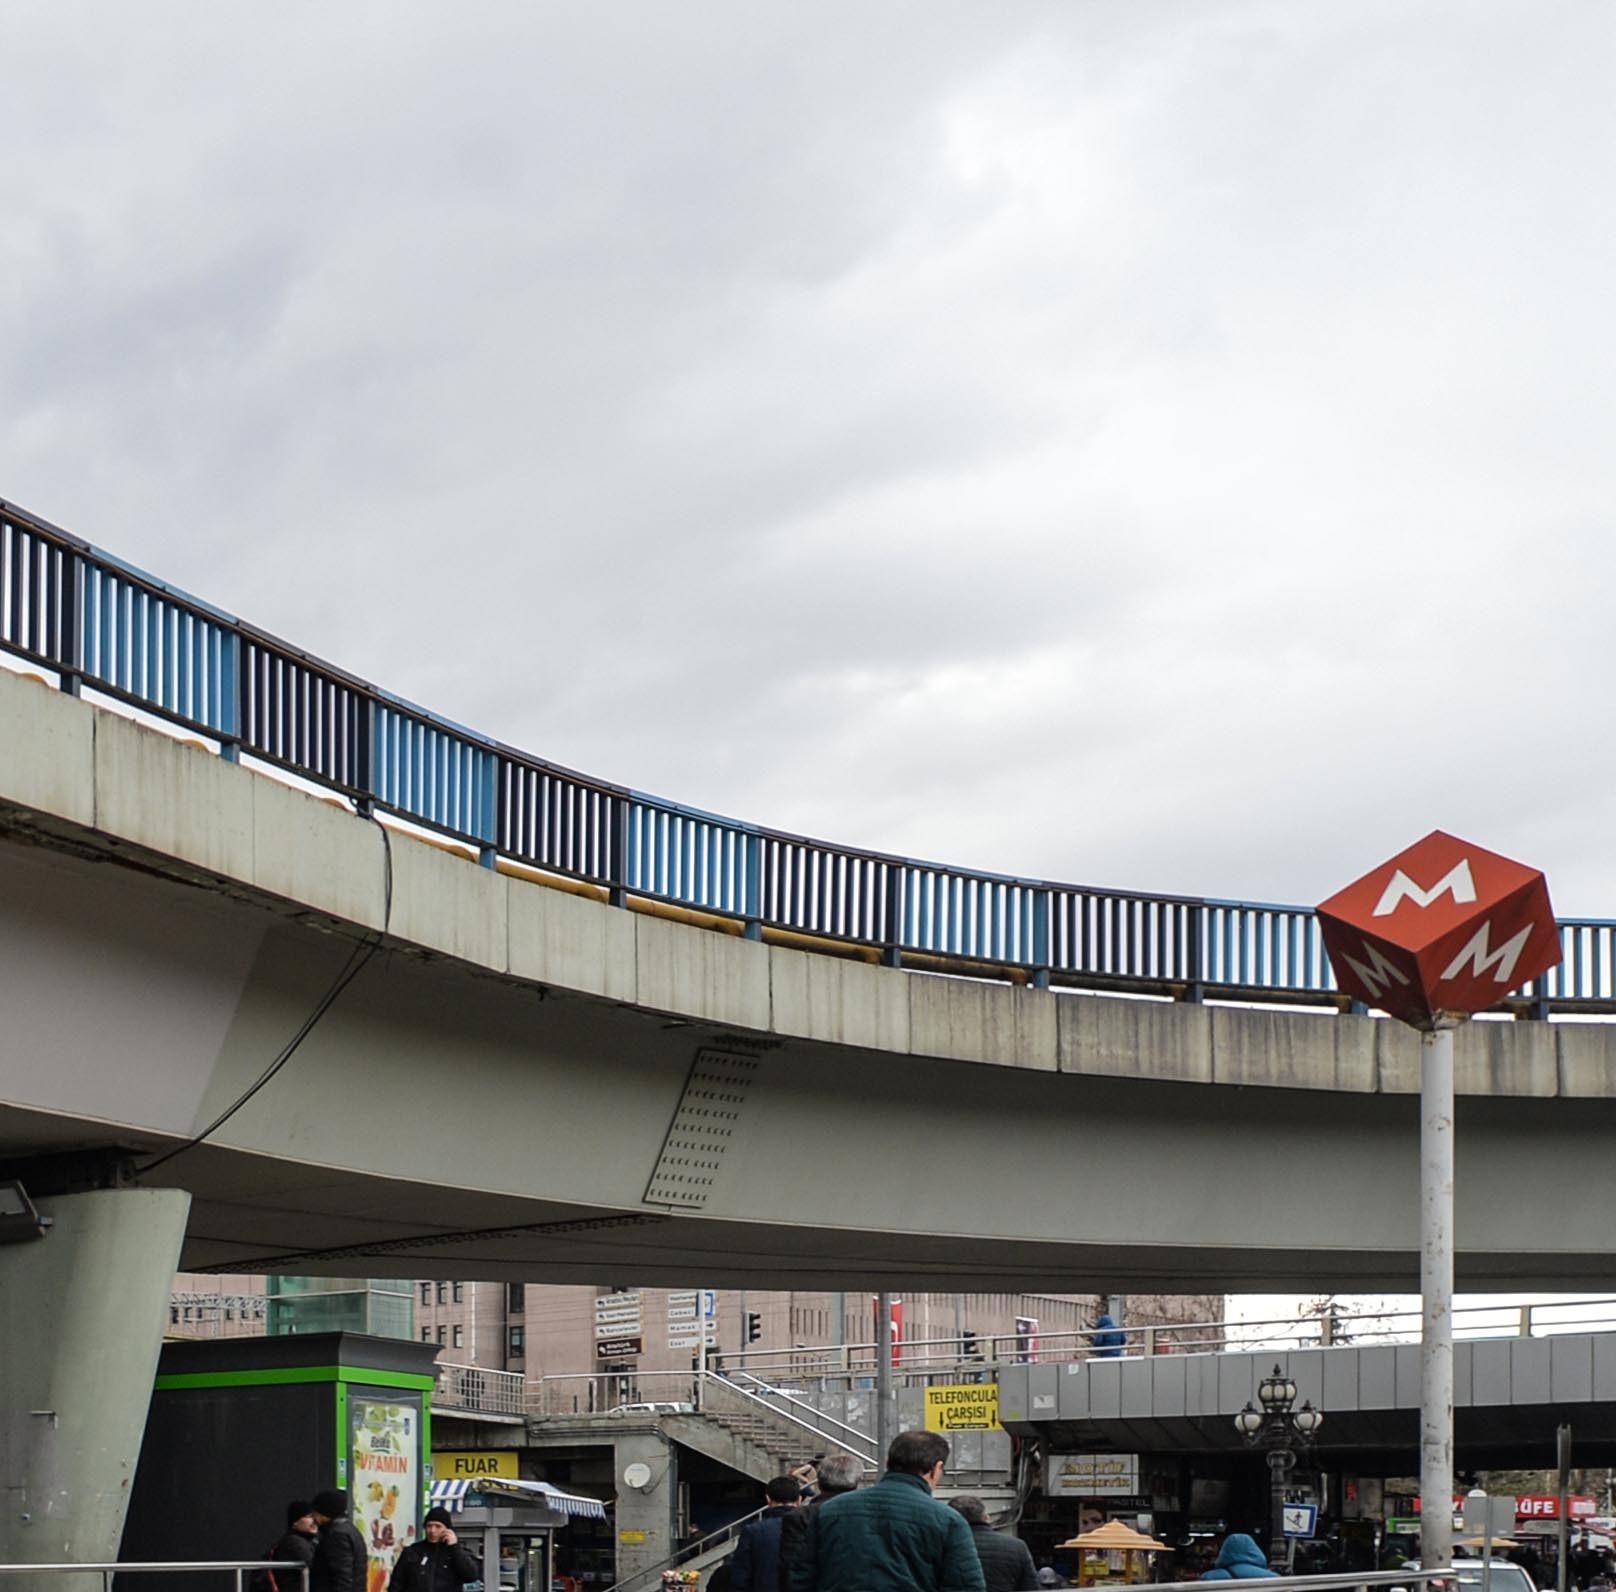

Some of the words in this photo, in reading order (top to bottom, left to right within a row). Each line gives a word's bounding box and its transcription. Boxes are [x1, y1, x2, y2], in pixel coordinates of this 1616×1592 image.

[1371, 857, 1478, 918] M
[1339, 938, 1411, 1000] M
[1439, 919, 1535, 983] M
[455, 1458, 499, 1474] FUAR
